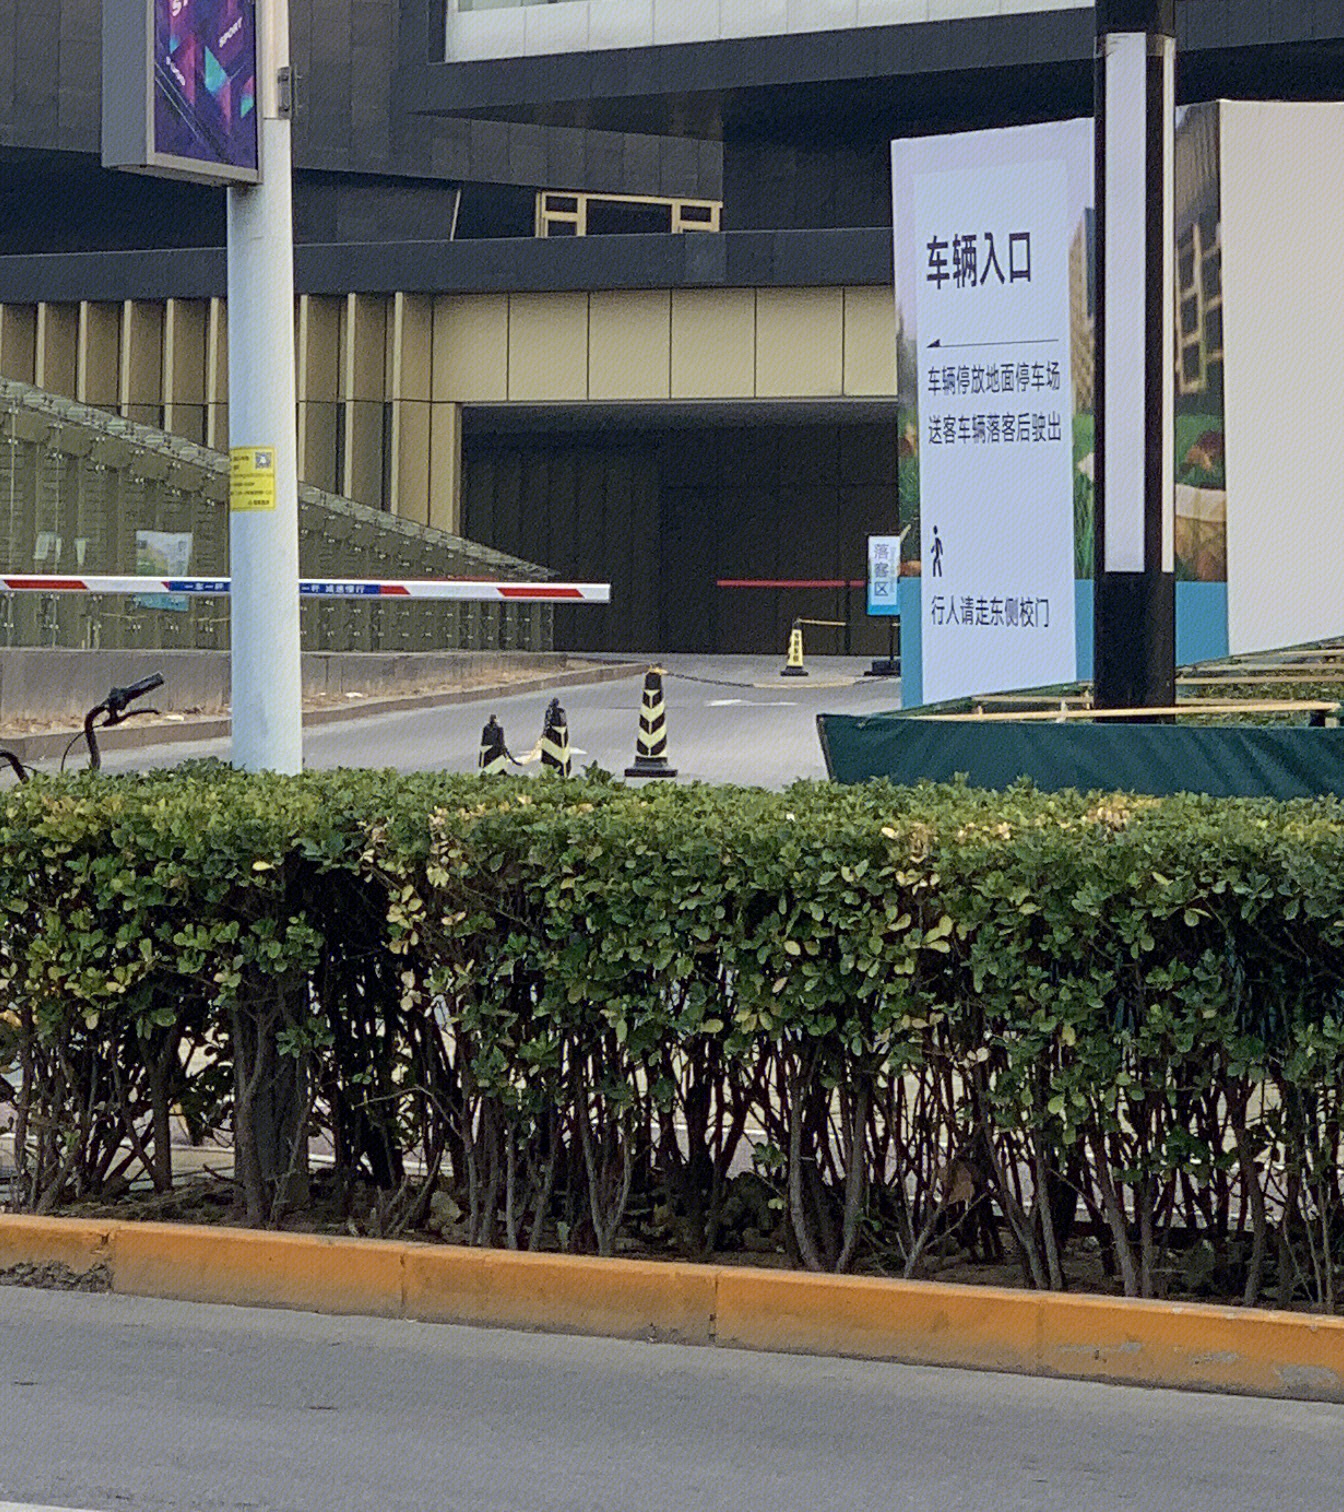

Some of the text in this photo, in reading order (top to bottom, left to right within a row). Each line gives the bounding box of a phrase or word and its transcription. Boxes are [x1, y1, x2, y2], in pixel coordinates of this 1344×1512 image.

[926, 232, 1031, 290] 车辆入口
[928, 361, 1061, 397] 车辆停放地面停车场
[928, 410, 1062, 445] 送客车辆落客后驶出
[874, 543, 889, 597] 落客区
[931, 595, 1049, 628] 行人请走东侧校门
